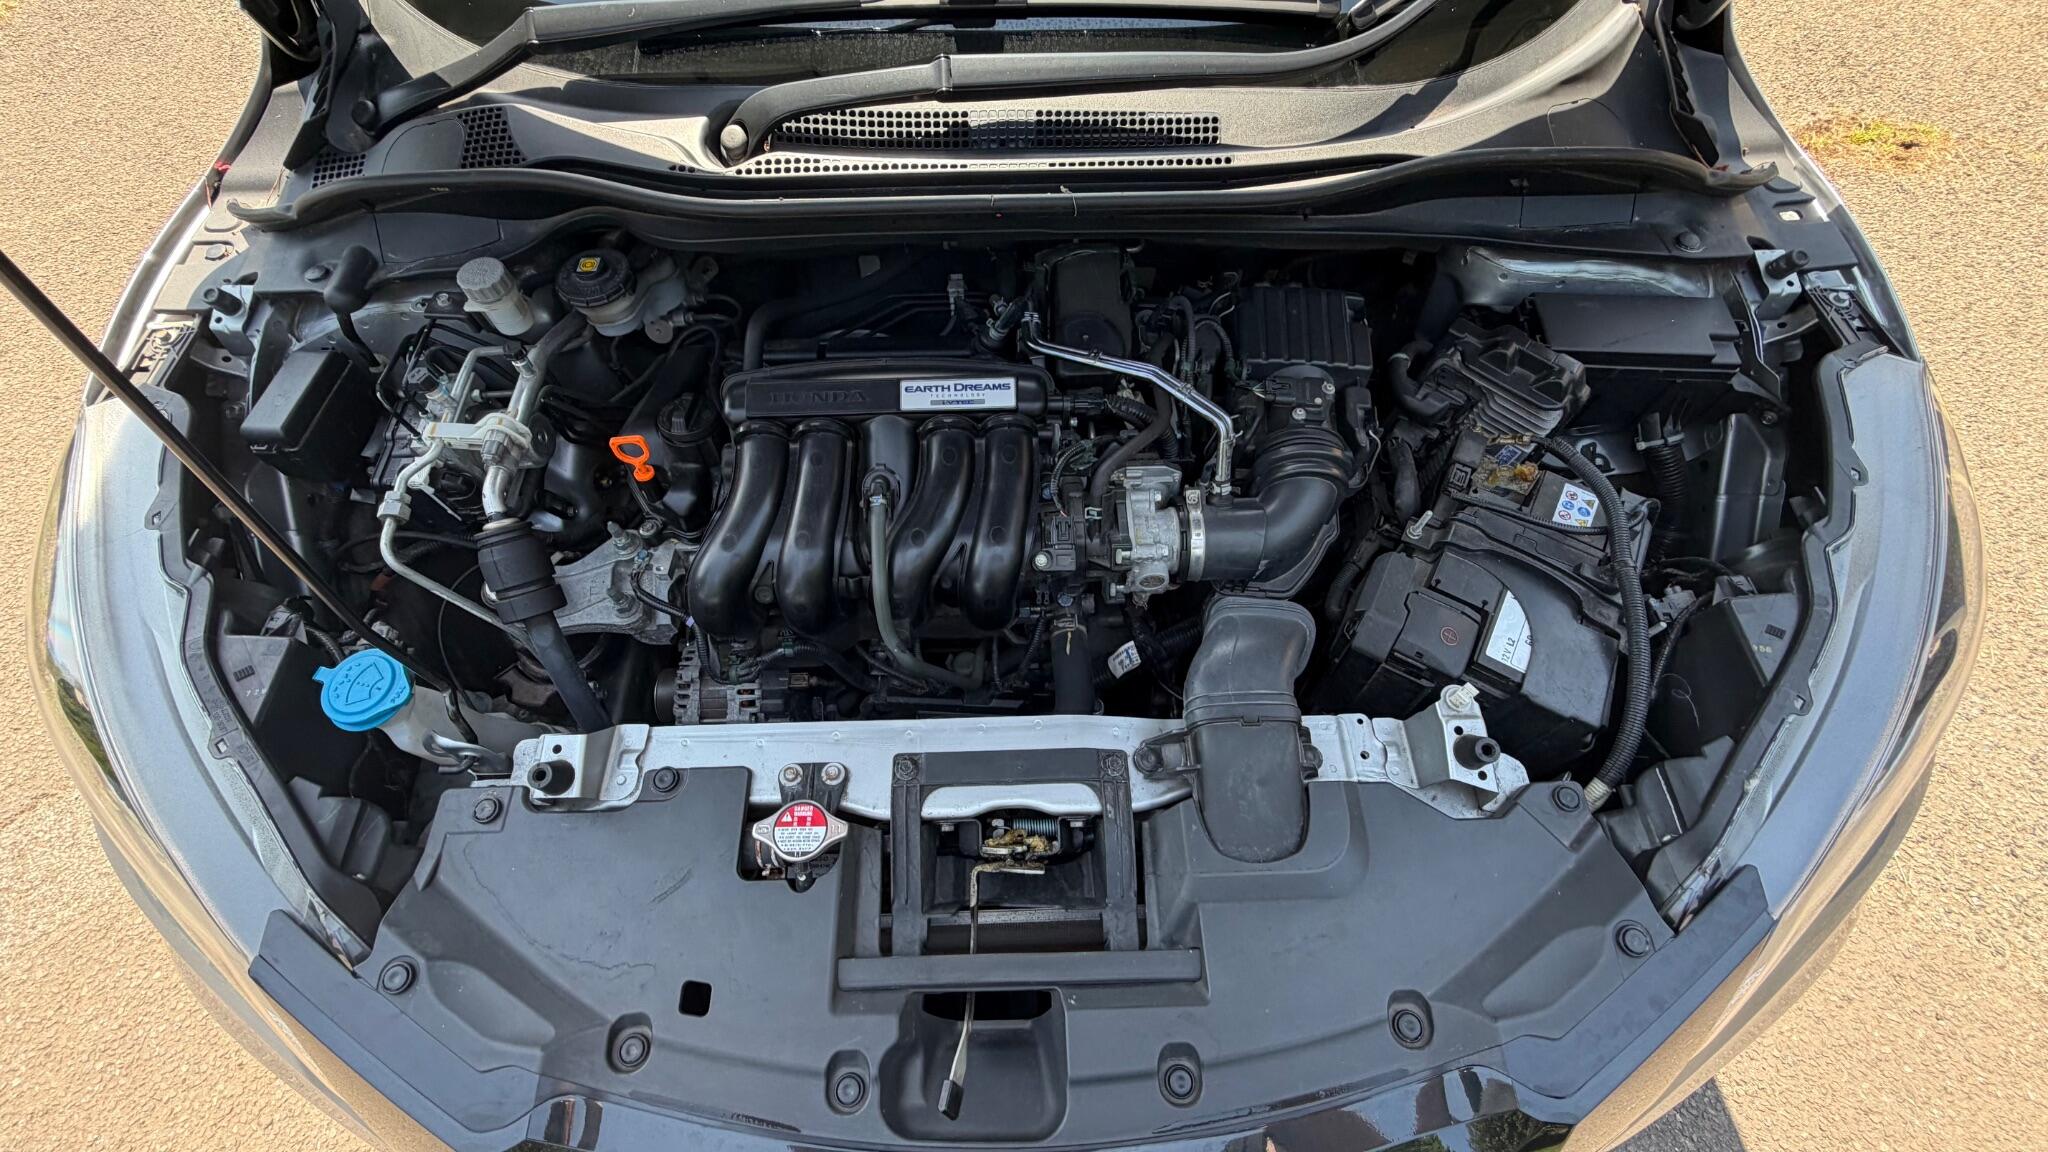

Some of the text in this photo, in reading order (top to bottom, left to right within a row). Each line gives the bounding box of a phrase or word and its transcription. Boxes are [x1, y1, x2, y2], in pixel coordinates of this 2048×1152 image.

[905, 382, 1011, 393] EARTH DREAMS
[768, 389, 867, 404] HONDA
[1501, 637, 1515, 663] 12V L2
